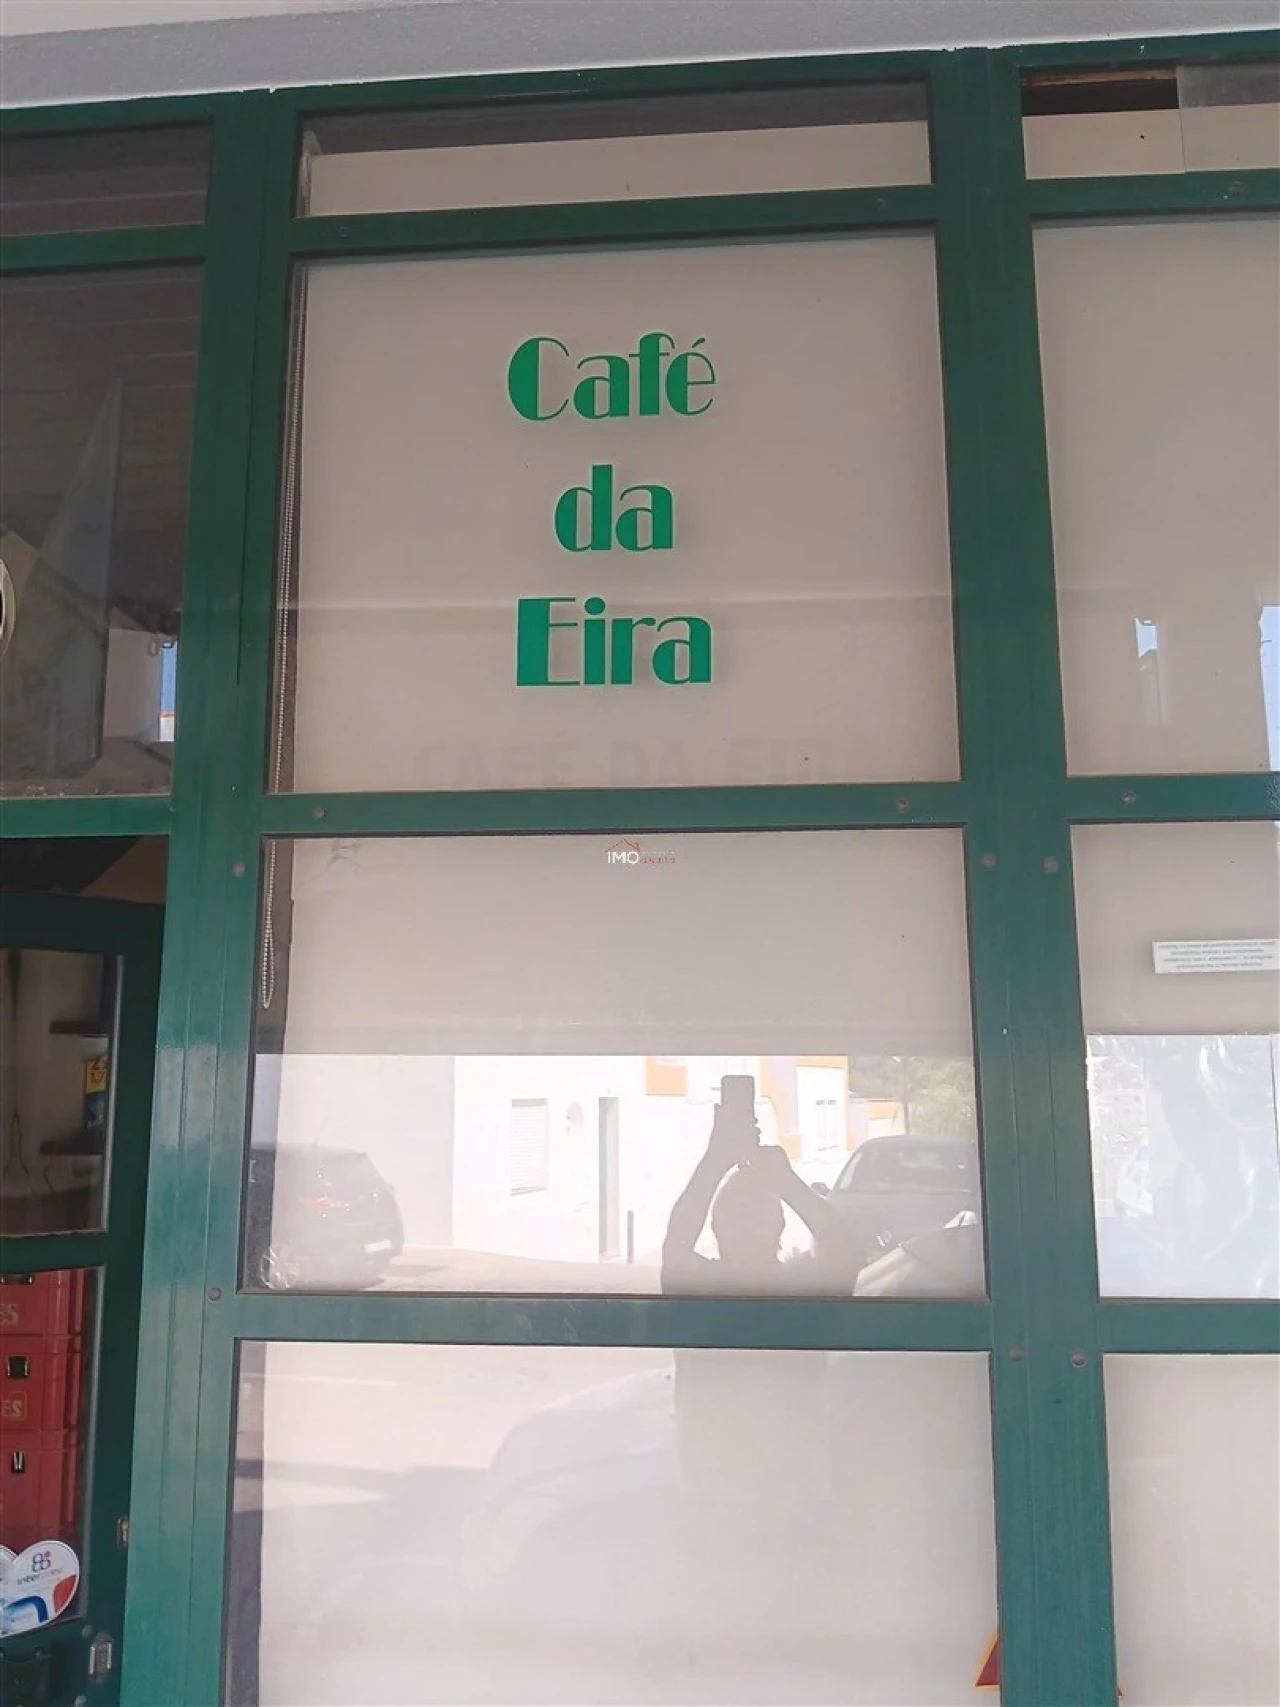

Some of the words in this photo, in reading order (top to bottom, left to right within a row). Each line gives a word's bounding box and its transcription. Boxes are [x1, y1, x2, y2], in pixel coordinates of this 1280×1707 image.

[507, 332, 716, 421] Café
[554, 464, 674, 552] da
[516, 597, 712, 686] Eira
